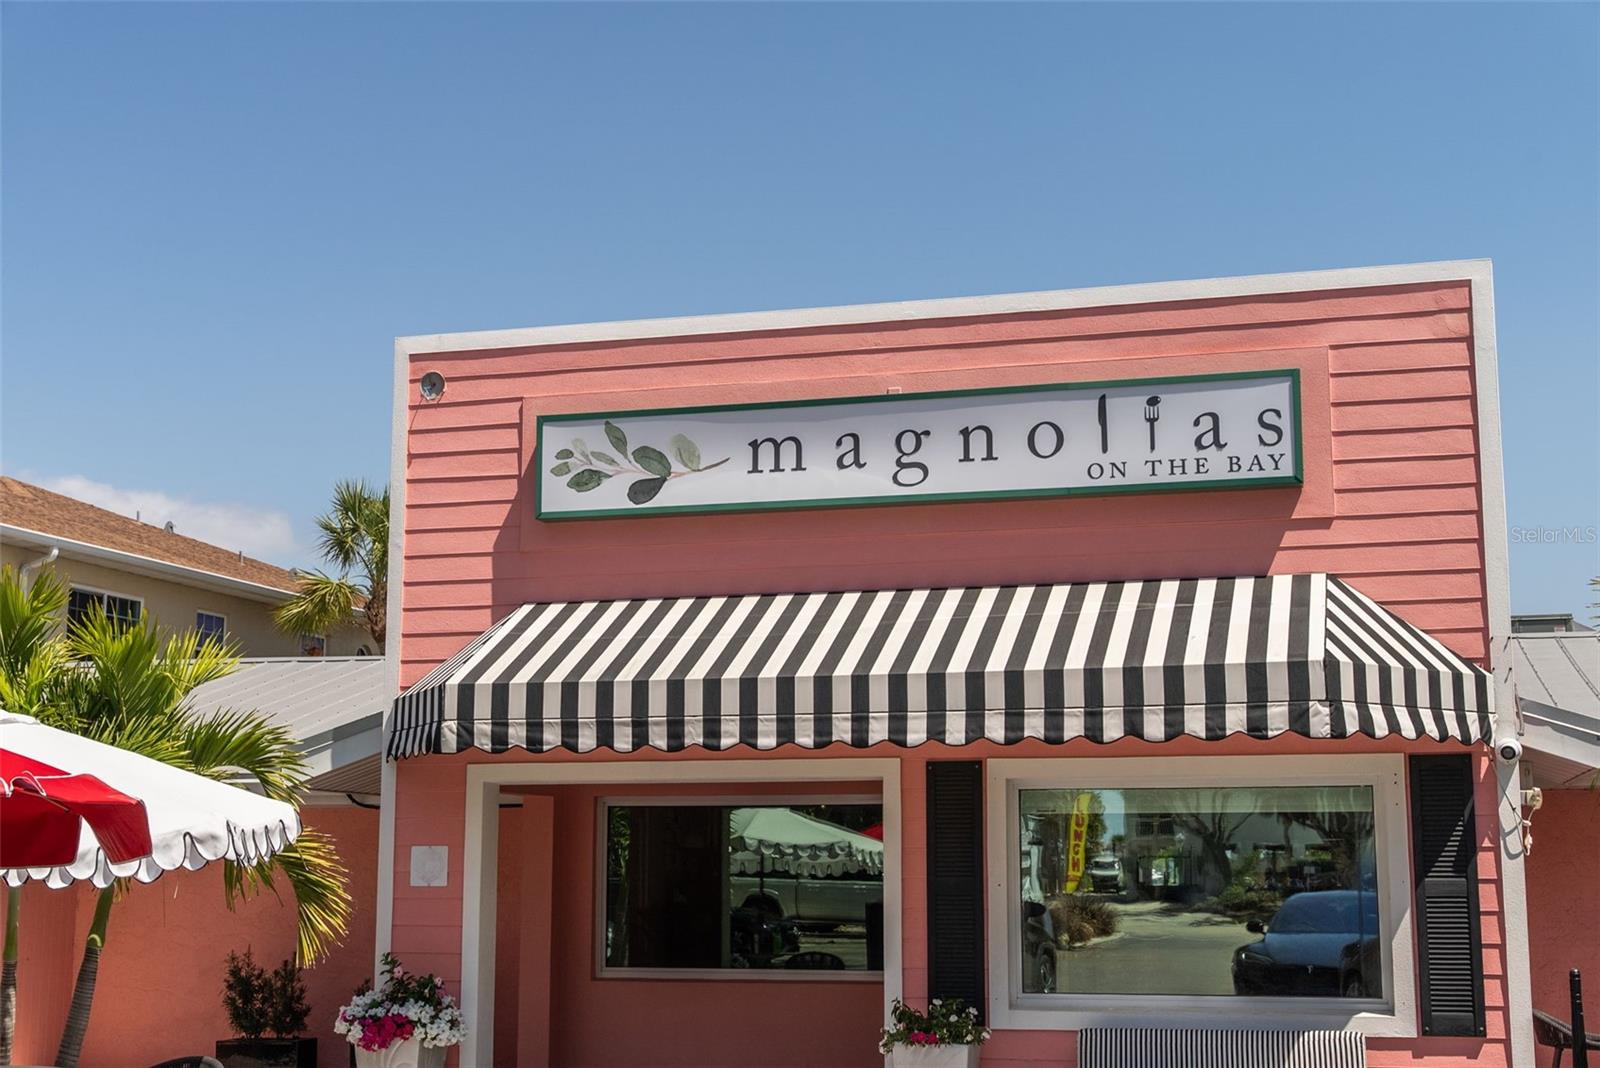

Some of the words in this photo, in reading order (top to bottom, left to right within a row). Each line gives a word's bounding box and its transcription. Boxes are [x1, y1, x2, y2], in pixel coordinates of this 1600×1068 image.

[747, 394, 1284, 487] magnolias
[1087, 461, 1127, 480] ON
[1144, 457, 1210, 477] THE
[1227, 453, 1286, 473] BAY
